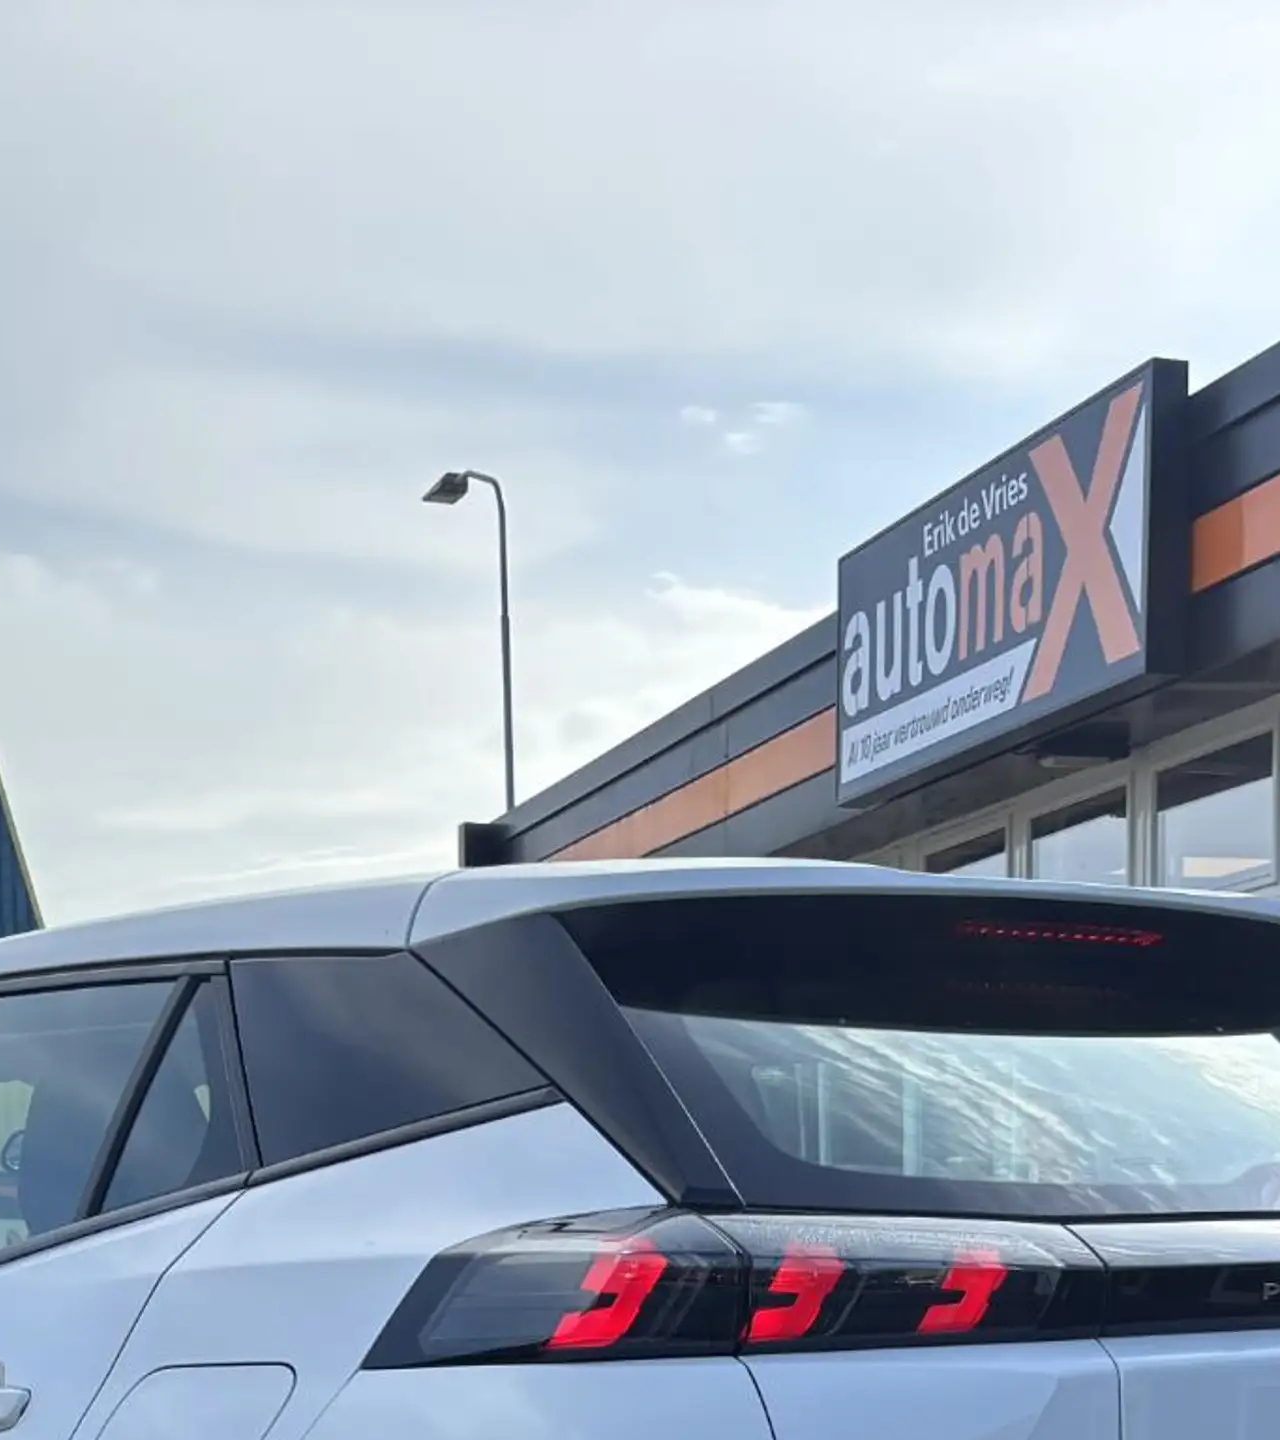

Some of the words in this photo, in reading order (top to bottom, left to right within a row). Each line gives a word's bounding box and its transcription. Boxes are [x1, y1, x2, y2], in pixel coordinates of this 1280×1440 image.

[923, 509, 956, 557] Erik
[958, 496, 980, 536] de
[981, 472, 1028, 520] Vries
[870, 728, 896, 762] jaar
[894, 697, 952, 746] vertrouwd
[950, 665, 1015, 721] onderweg!
